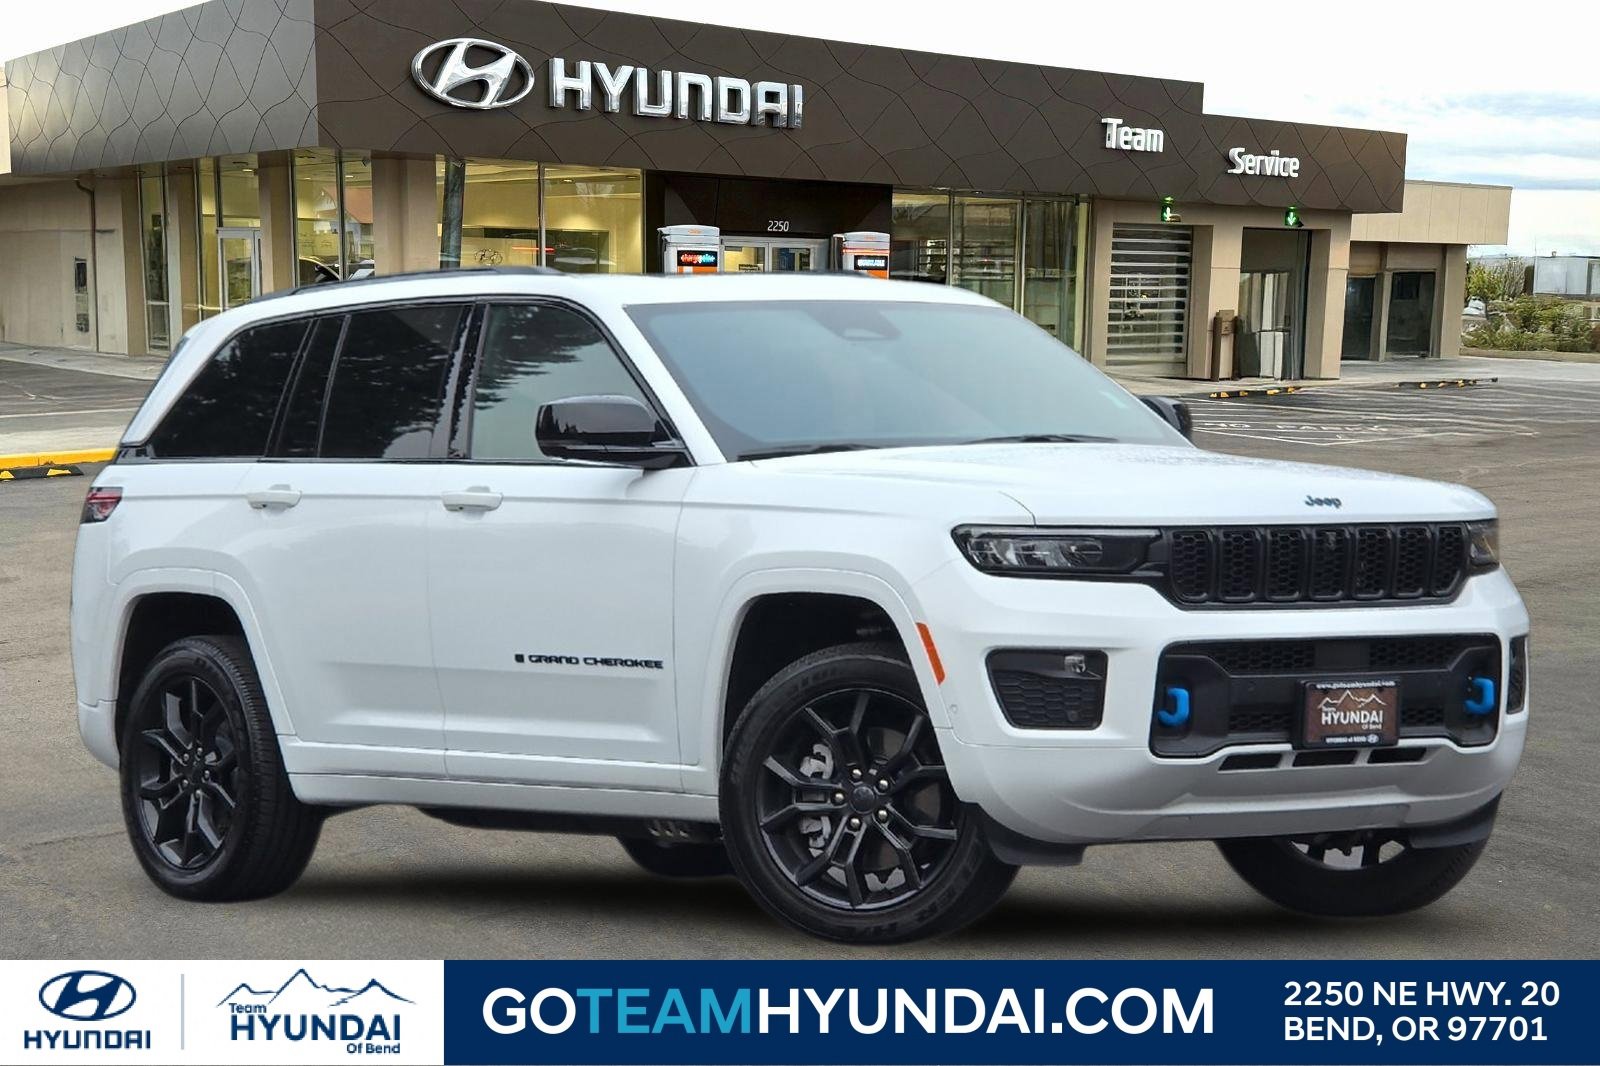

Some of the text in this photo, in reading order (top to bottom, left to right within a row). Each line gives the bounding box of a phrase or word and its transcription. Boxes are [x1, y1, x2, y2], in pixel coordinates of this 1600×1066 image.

[548, 57, 803, 129] HYUNDAI
[1101, 117, 1164, 152] Team
[1227, 147, 1300, 178] Service
[767, 220, 790, 232] 2250
[1304, 494, 1342, 509] Jeep
[528, 654, 664, 669] GRAND CHEROKEE
[1321, 710, 1384, 725] HYUNDAI
